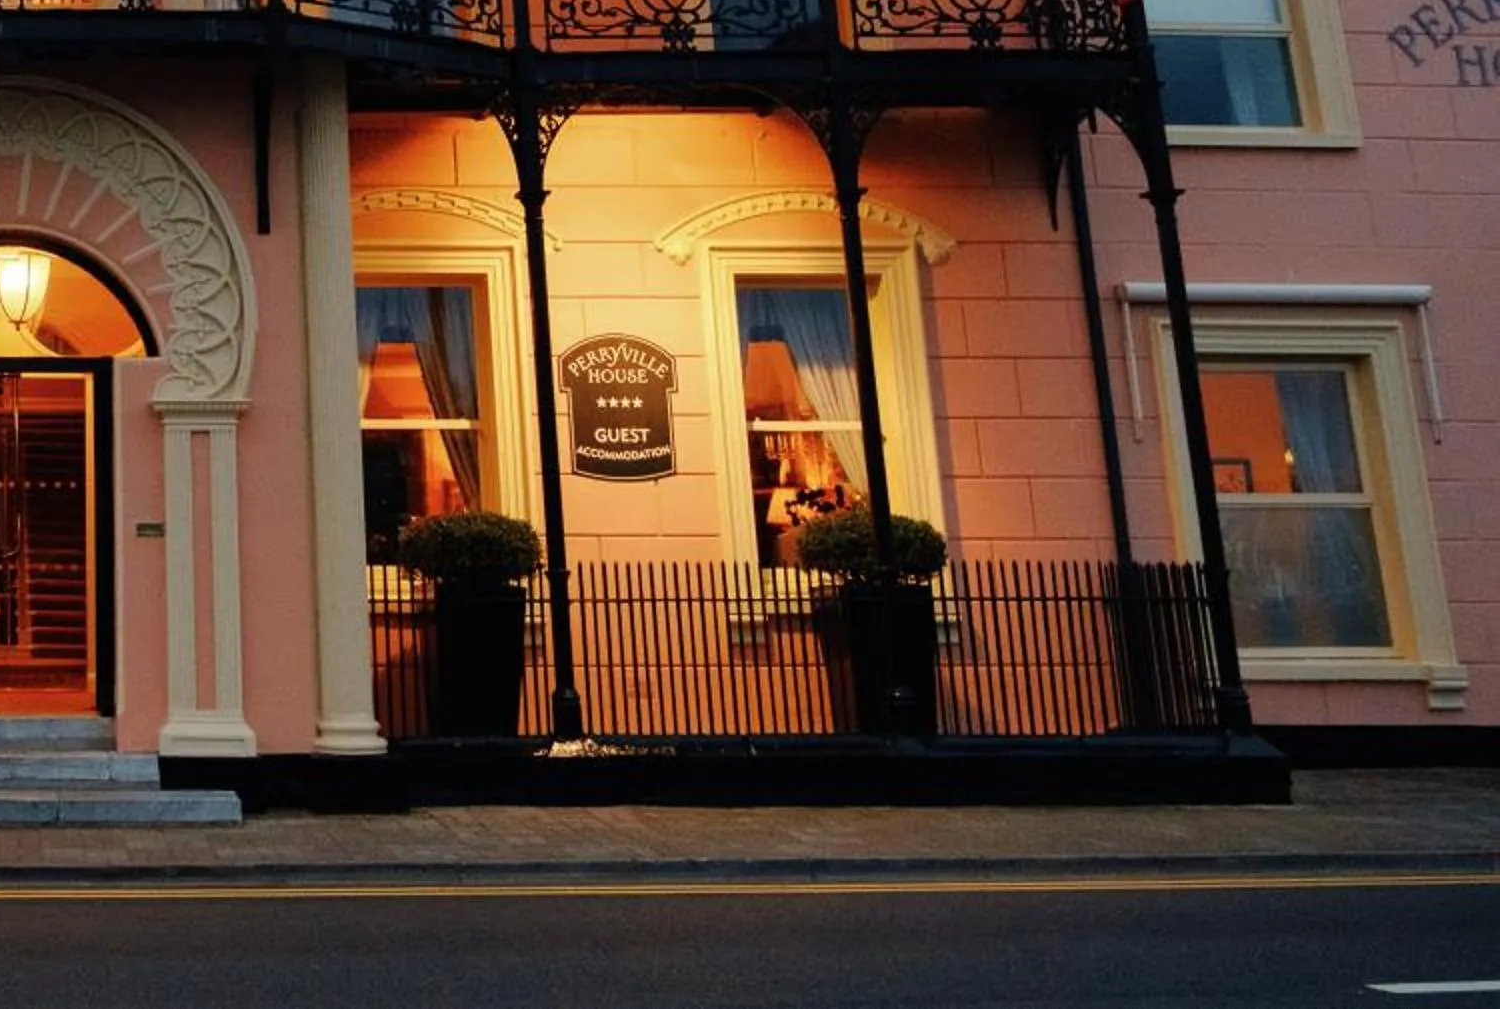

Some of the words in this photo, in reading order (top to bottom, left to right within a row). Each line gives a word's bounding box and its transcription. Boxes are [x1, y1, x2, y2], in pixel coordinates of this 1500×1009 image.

[567, 342, 669, 379] PERRYVILLE
[588, 368, 649, 384] HOUSE
[594, 428, 651, 443] GUEST
[576, 444, 671, 461] ACCOMMODATION
